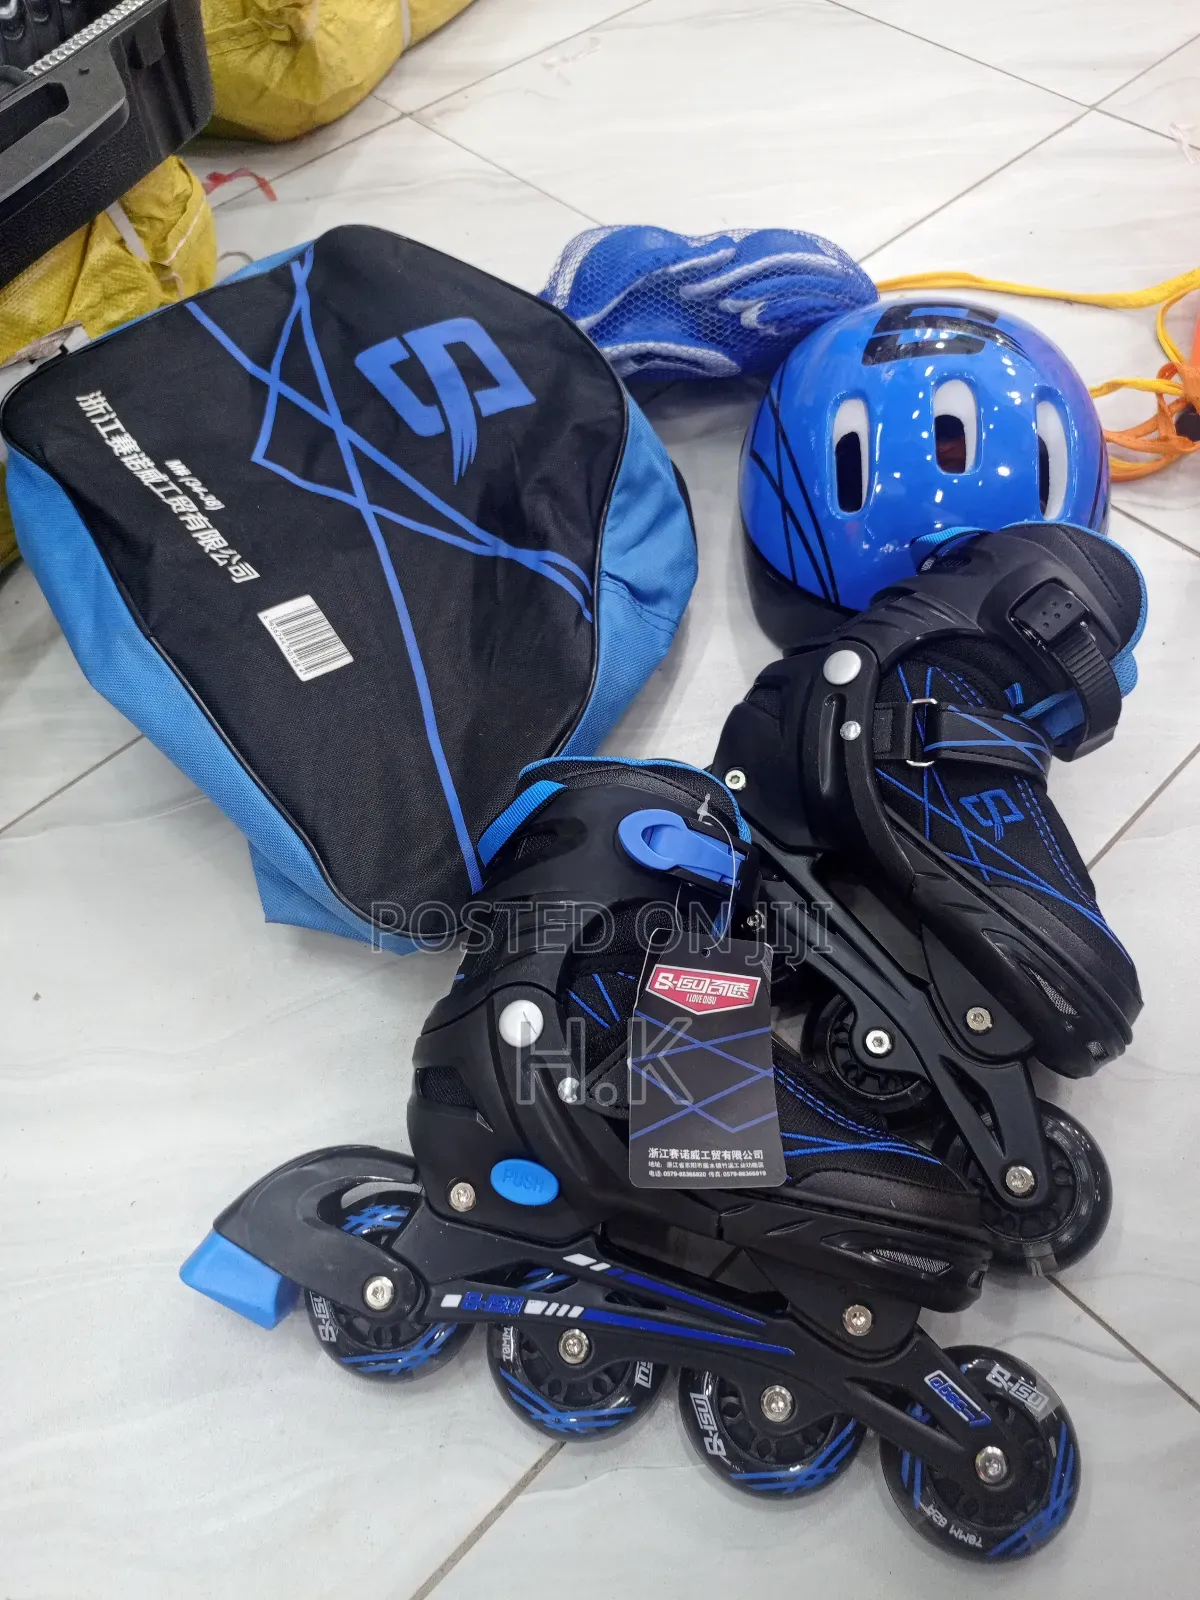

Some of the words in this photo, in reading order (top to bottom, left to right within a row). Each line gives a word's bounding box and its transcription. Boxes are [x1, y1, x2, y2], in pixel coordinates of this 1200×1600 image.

[76, 390, 260, 583] 浙江赛诺威工贸有限公司
[689, 994, 703, 1004] LOVE
[648, 1147, 764, 1160] 浙江赛诺威工贸有限公司
[502, 1168, 545, 1194] PUSH
[949, 1526, 983, 1548] 70MM
